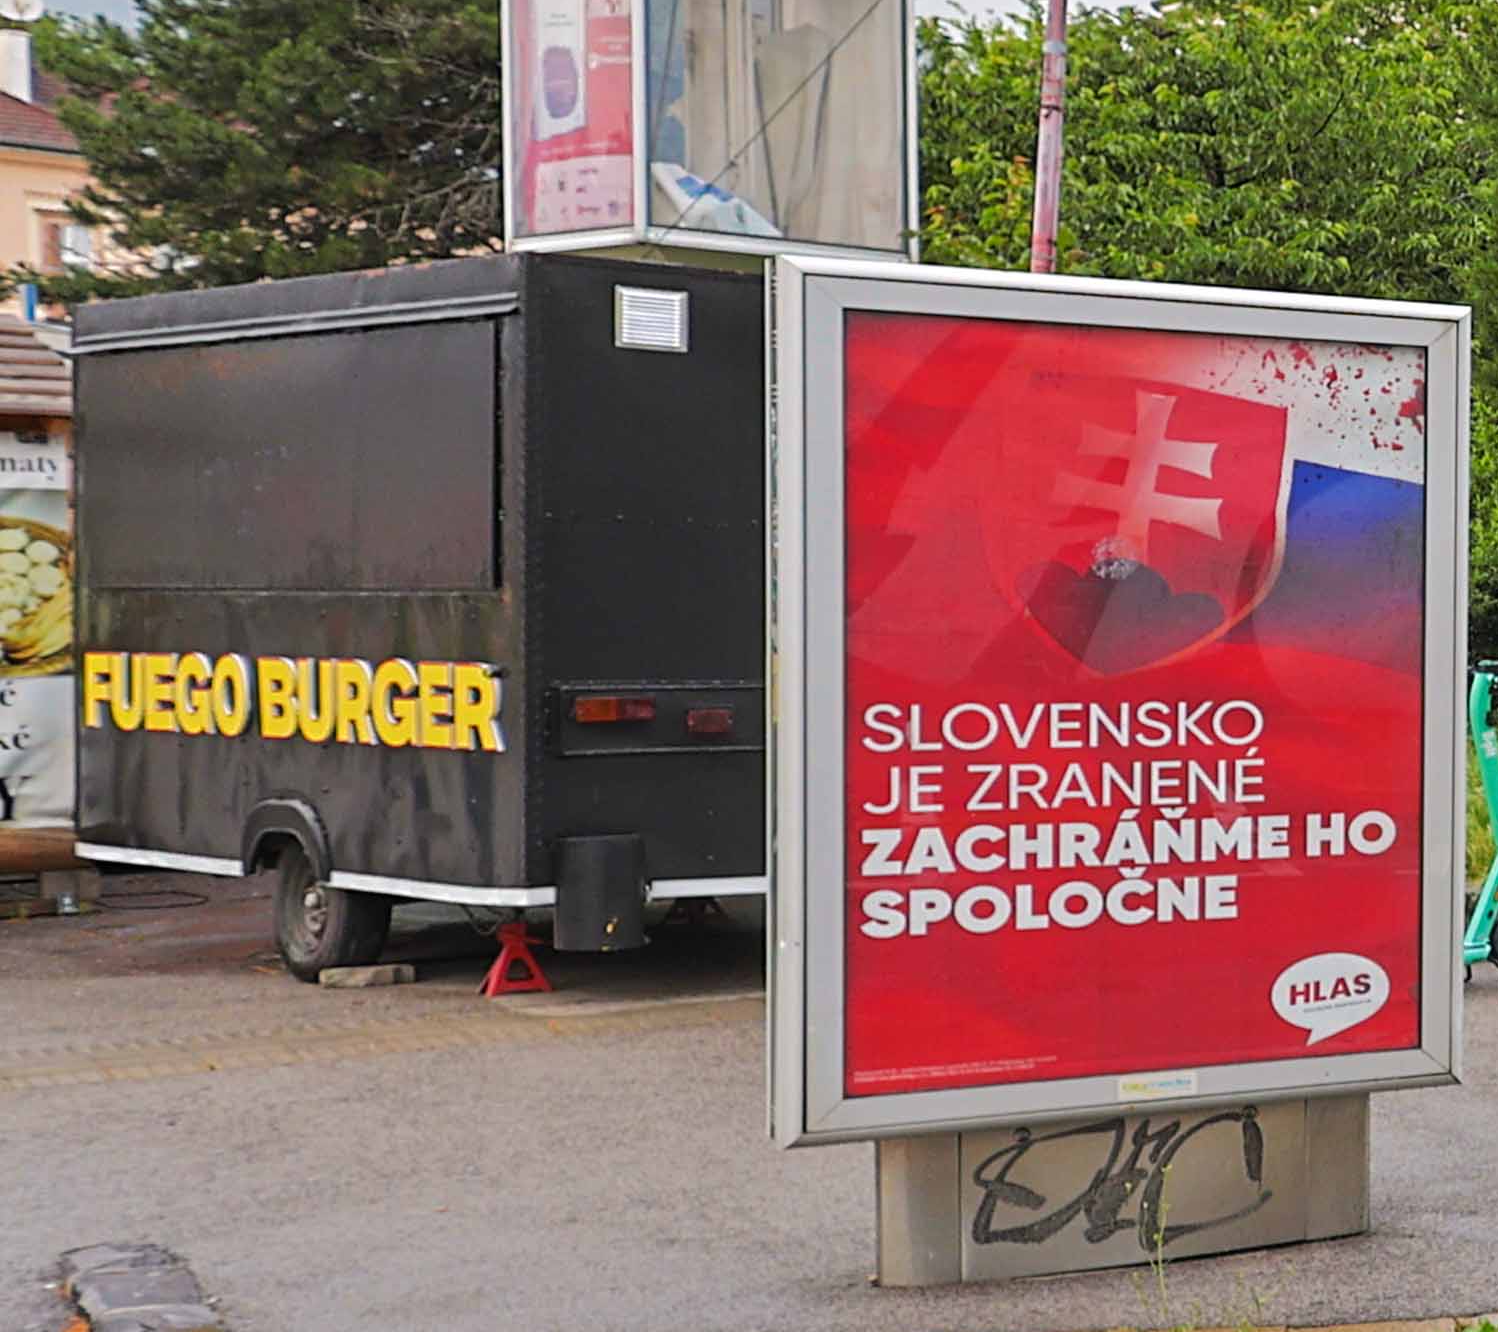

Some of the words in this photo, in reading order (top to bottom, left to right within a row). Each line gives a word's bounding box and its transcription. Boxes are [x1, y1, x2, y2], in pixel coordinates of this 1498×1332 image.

[83, 651, 250, 738] FUEGO
[257, 655, 506, 752] BURGER
[861, 699, 1265, 753] SLOVENSKO
[863, 765, 944, 815] JE
[966, 747, 1266, 812] ZRANENÉ
[860, 806, 1291, 877] ZACHRÁŇME
[1306, 810, 1397, 857] HO
[860, 866, 1239, 940] SPOLOČNE
[1289, 973, 1371, 1006] HLAS
